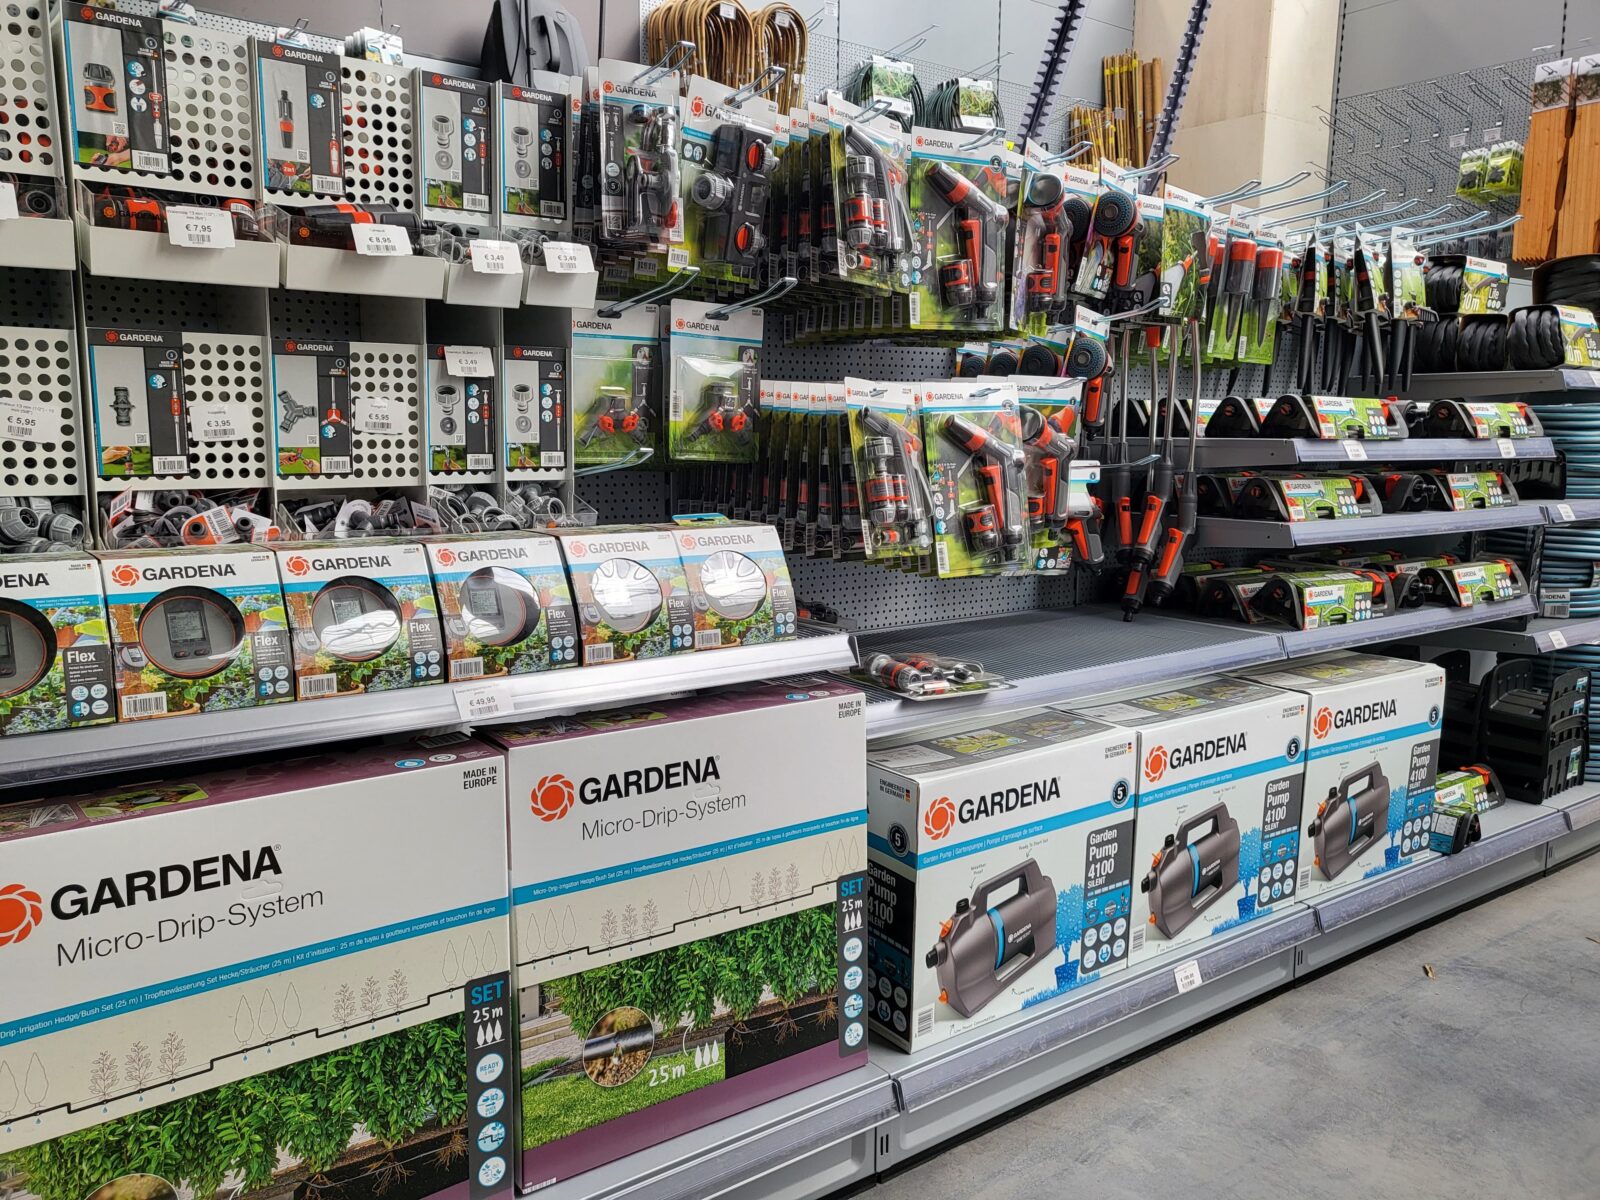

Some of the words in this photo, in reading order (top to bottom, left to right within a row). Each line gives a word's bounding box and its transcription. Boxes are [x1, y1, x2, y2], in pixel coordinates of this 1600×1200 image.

[96, 12, 142, 28] GARDENA
[284, 50, 323, 63] GARDENA
[442, 78, 476, 90] GARDENA
[521, 90, 552, 102] GARDENA
[615, 85, 657, 98] GARDENA
[924, 139, 953, 150] GARDENA
[1070, 175, 1088, 185] GARDENA
[1143, 202, 1162, 211] GARDENA
[193, 224, 212, 232] 7,95
[1234, 220, 1250, 230] GARDENA
[1260, 230, 1277, 239] GARDENA
[576, 321, 612, 330] GARDENA
[686, 321, 720, 332] GARDENA
[119, 334, 163, 342] GARDENA
[296, 343, 334, 352] GARDENA
[852, 389, 868, 397] GARDENA
[934, 392, 963, 400] GARDENA
[16, 417, 36, 426] 5,95
[698, 534, 755, 546] GARDENA
[588, 541, 650, 554] GARDENA
[458, 548, 526, 562] GARDENA
[312, 556, 391, 571] GARDENA
[142, 565, 236, 580] GARDENA
[772, 588, 787, 598] Flex
[668, 599, 684, 609] Flex
[548, 608, 565, 619] Flex
[410, 622, 431, 632] Flex
[254, 635, 278, 646] Flex
[67, 650, 96, 663] Flex
[476, 696, 495, 705] 49,95
[838, 702, 853, 711] MADE
[838, 707, 862, 719] EUROPE
[1334, 699, 1396, 729] GARDENA
[1105, 744, 1127, 753] ENGINEERED
[1110, 750, 1127, 758] GERMANY
[1170, 732, 1247, 769] GARDENA
[1290, 744, 1296, 754] 5
[1413, 743, 1430, 756] Garden
[1412, 754, 1430, 767] Pump
[463, 768, 486, 780] MADE
[489, 766, 497, 775] IN
[1410, 767, 1427, 782] 4100
[463, 776, 497, 790] EUROPE
[579, 756, 720, 804] GARDENA
[880, 779, 904, 793] ENGINEERED
[1117, 787, 1124, 798] 5
[1267, 780, 1290, 793] Garden
[885, 788, 904, 800] GERMANY
[1266, 792, 1290, 808] Pump
[958, 777, 1060, 824] GARDENA
[582, 794, 746, 841] Micro-Drip-System
[1265, 806, 1286, 823] 4100
[1264, 821, 1279, 832] SILENT
[895, 833, 902, 847] 5
[1090, 829, 1117, 845] Garden
[1090, 842, 1118, 861] Pump
[1263, 841, 1272, 850] SET
[1088, 858, 1114, 879] 4100
[868, 863, 896, 887] Garden
[50, 846, 282, 920] GARDENA
[841, 878, 864, 897] SET
[1088, 877, 1106, 889] SILENT
[868, 878, 897, 907] Pump
[868, 897, 893, 924] 4100
[1086, 899, 1097, 910] SET
[57, 890, 324, 966] Micro-Drip-System
[54, 1007, 100, 1024] Hedge/Bush
[102, 1003, 113, 1013] Set
[115, 999, 127, 1010] (25
[129, 997, 138, 1006] m)
[144, 980, 205, 1000] Tropfbewässerung
[206, 975, 218, 985] Set
[219, 962, 270, 983] Hecke/Sträucher
[272, 960, 282, 969] (25
[283, 957, 292, 966] m)
[296, 952, 305, 961] Kit
[340, 941, 348, 949] 25
[364, 934, 379, 944] tuyau
[446, 913, 467, 923] bouchon
[483, 906, 496, 915] ligne
[471, 980, 504, 1005] SET
[480, 1061, 500, 1073] READY
